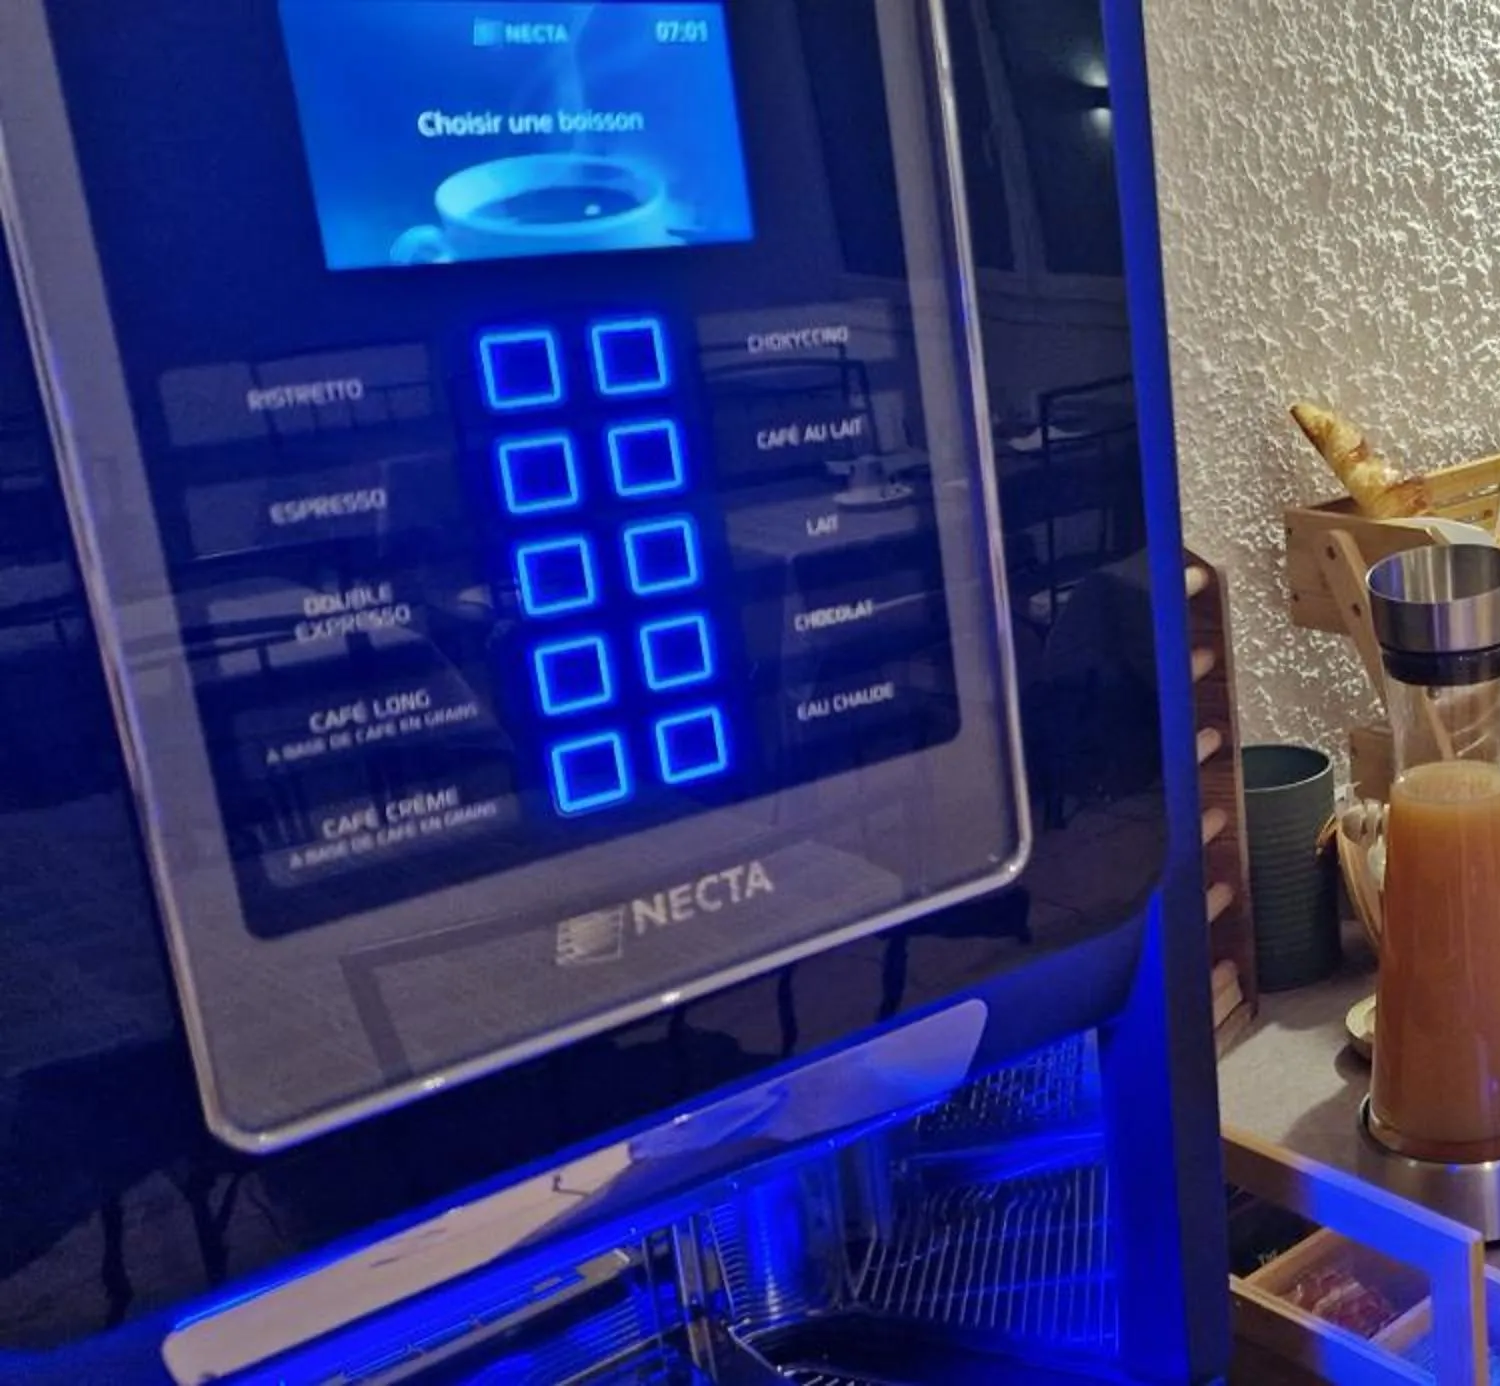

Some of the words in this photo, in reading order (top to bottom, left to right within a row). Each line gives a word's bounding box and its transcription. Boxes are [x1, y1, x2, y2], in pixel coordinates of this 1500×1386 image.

[505, 23, 569, 43] NECTA
[655, 20, 709, 42] 07:01
[417, 111, 502, 137] Choisir
[508, 115, 552, 134] une
[557, 109, 645, 132] boisson
[247, 378, 364, 411] RISTRETTO
[804, 424, 827, 441] AU
[830, 416, 862, 439] LAIT
[269, 488, 387, 525] ESPRESSO
[806, 514, 838, 536] LAIT
[303, 583, 393, 617] DOUBLE
[294, 604, 410, 642] EXPRESSO
[794, 599, 873, 632] CHOCOLAT
[373, 689, 431, 718] LONG
[423, 702, 478, 728] GRAINS
[797, 700, 830, 721] EAU
[833, 682, 895, 713] CHAUDE
[444, 801, 497, 828] GRAINS
[631, 859, 774, 935] NECTA
